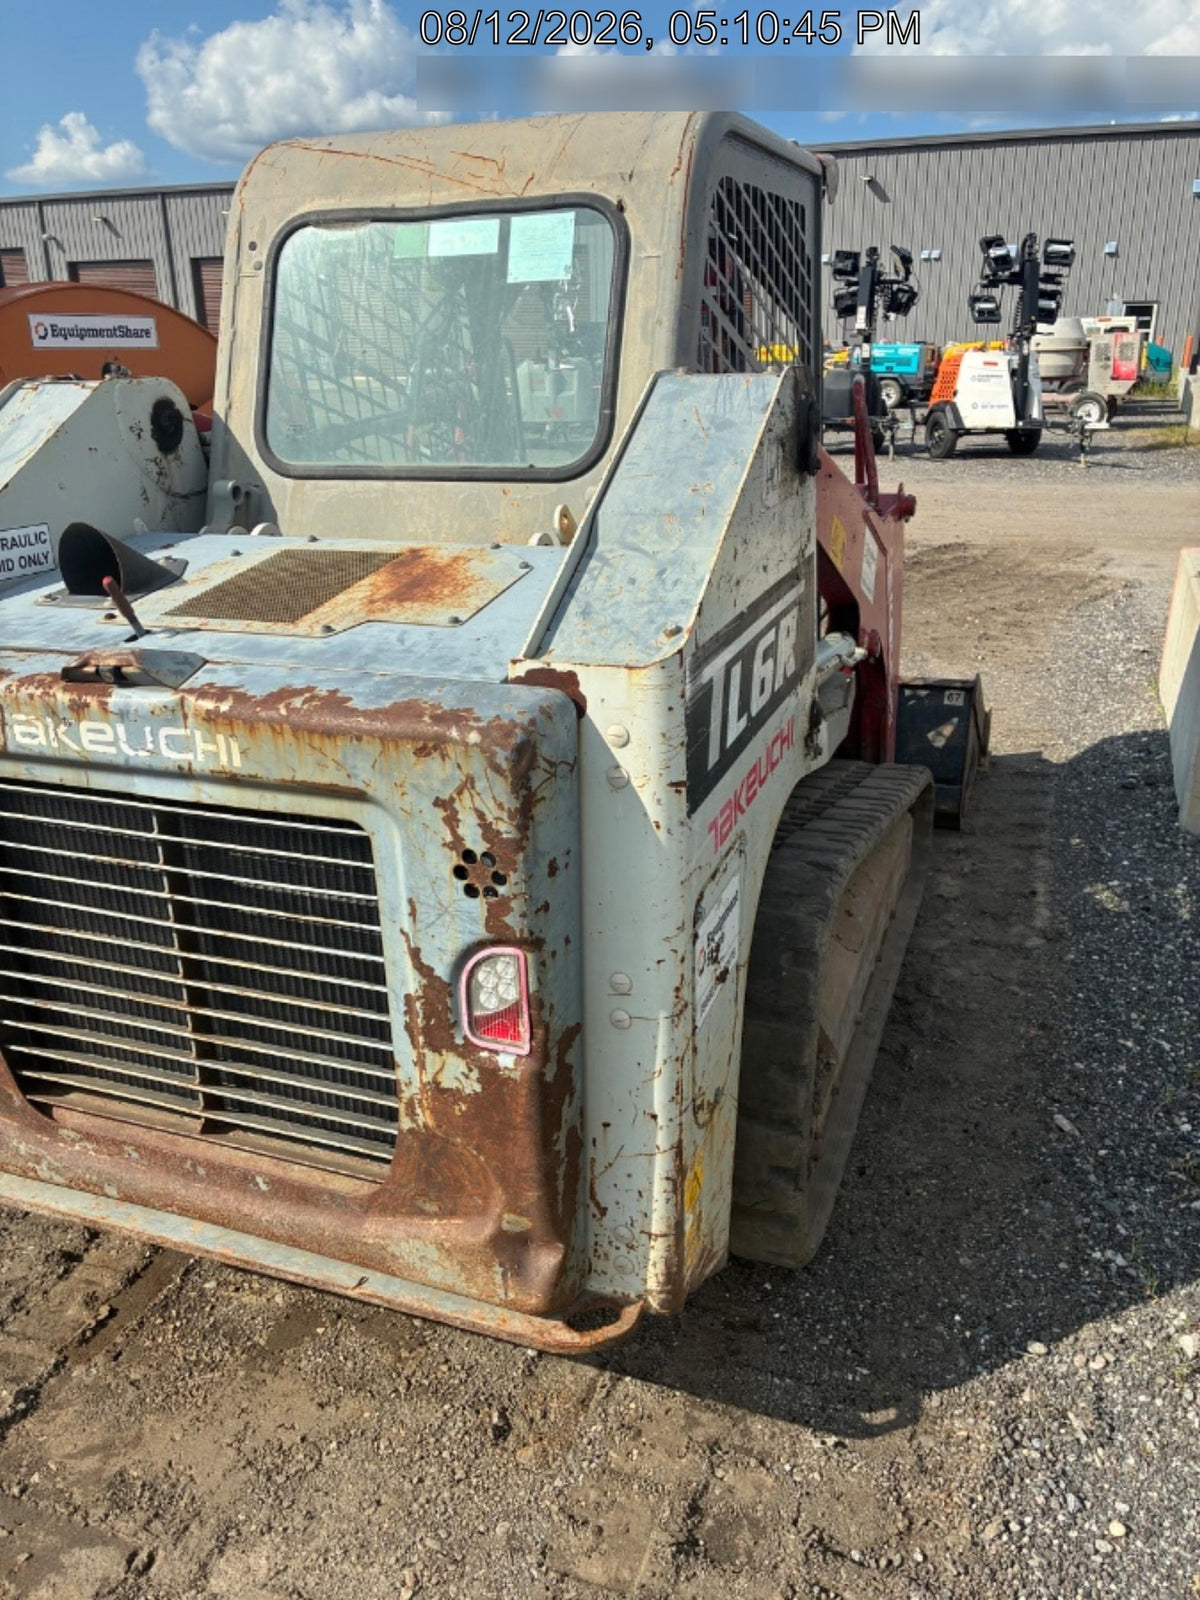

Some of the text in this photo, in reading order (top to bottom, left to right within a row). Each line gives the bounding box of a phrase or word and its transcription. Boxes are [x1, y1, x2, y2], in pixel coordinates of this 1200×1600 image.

[49, 324, 152, 340] EquipmentShare
[0, 531, 47, 551] RAULIC
[18, 550, 50, 569] ONLY
[690, 578, 805, 772] TL6R
